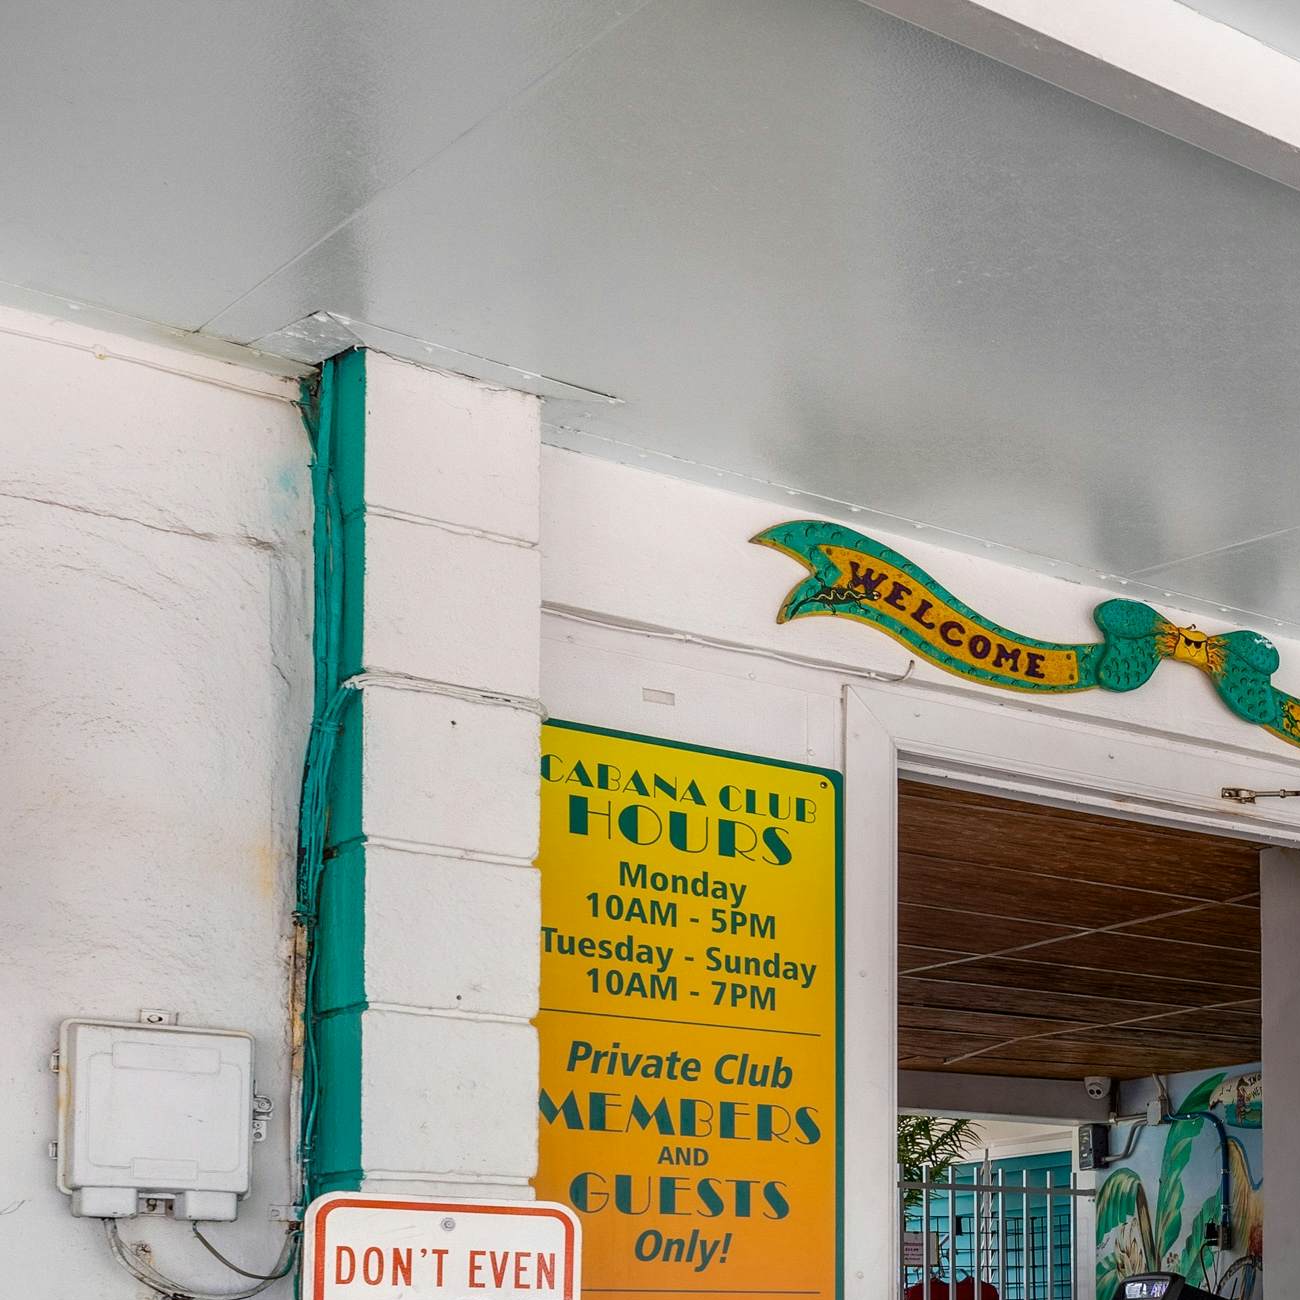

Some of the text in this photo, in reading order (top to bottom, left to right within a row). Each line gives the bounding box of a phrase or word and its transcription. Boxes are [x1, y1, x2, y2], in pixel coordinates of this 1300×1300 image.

[849, 560, 1046, 679] WELCOME
[540, 753, 817, 824] CABANA CLUB
[568, 794, 793, 866] HOURS
[619, 861, 747, 909] Monday
[586, 891, 677, 928] 10AM
[711, 908, 776, 940] 5PM
[541, 927, 674, 973] Tuesday
[706, 946, 817, 989] Sunday
[586, 967, 677, 1001] 10AM
[711, 980, 776, 1011] 7PM
[566, 1040, 793, 1089] Private Club
[538, 1088, 821, 1145] MEMBERS
[658, 1146, 709, 1166] AND
[569, 1171, 790, 1220] GUESTS
[335, 1245, 555, 1290] DON'T EVEN
[634, 1229, 733, 1273] Only!
